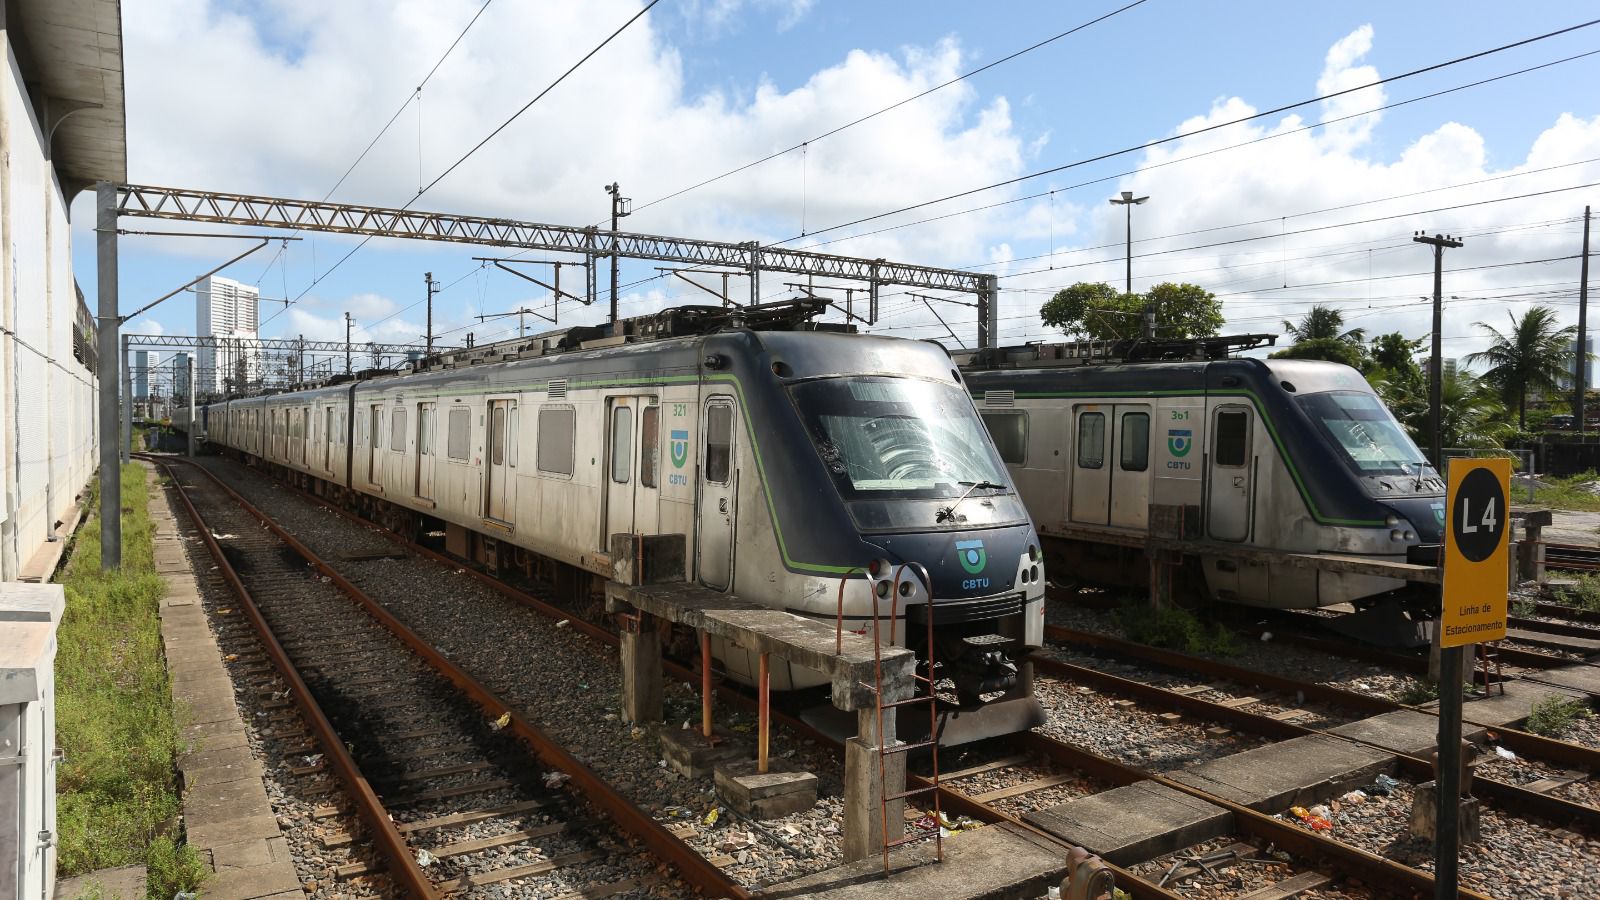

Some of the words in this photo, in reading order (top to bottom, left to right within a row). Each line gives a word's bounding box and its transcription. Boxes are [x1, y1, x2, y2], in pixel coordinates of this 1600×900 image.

[673, 404, 687, 417] 321
[1167, 461, 1191, 470] CBTU
[669, 474, 687, 486] CBTU
[962, 578, 989, 590] CBTU
[1459, 605, 1479, 616] Linha
[1482, 603, 1491, 613] de
[1445, 621, 1503, 636] Estacionamento
